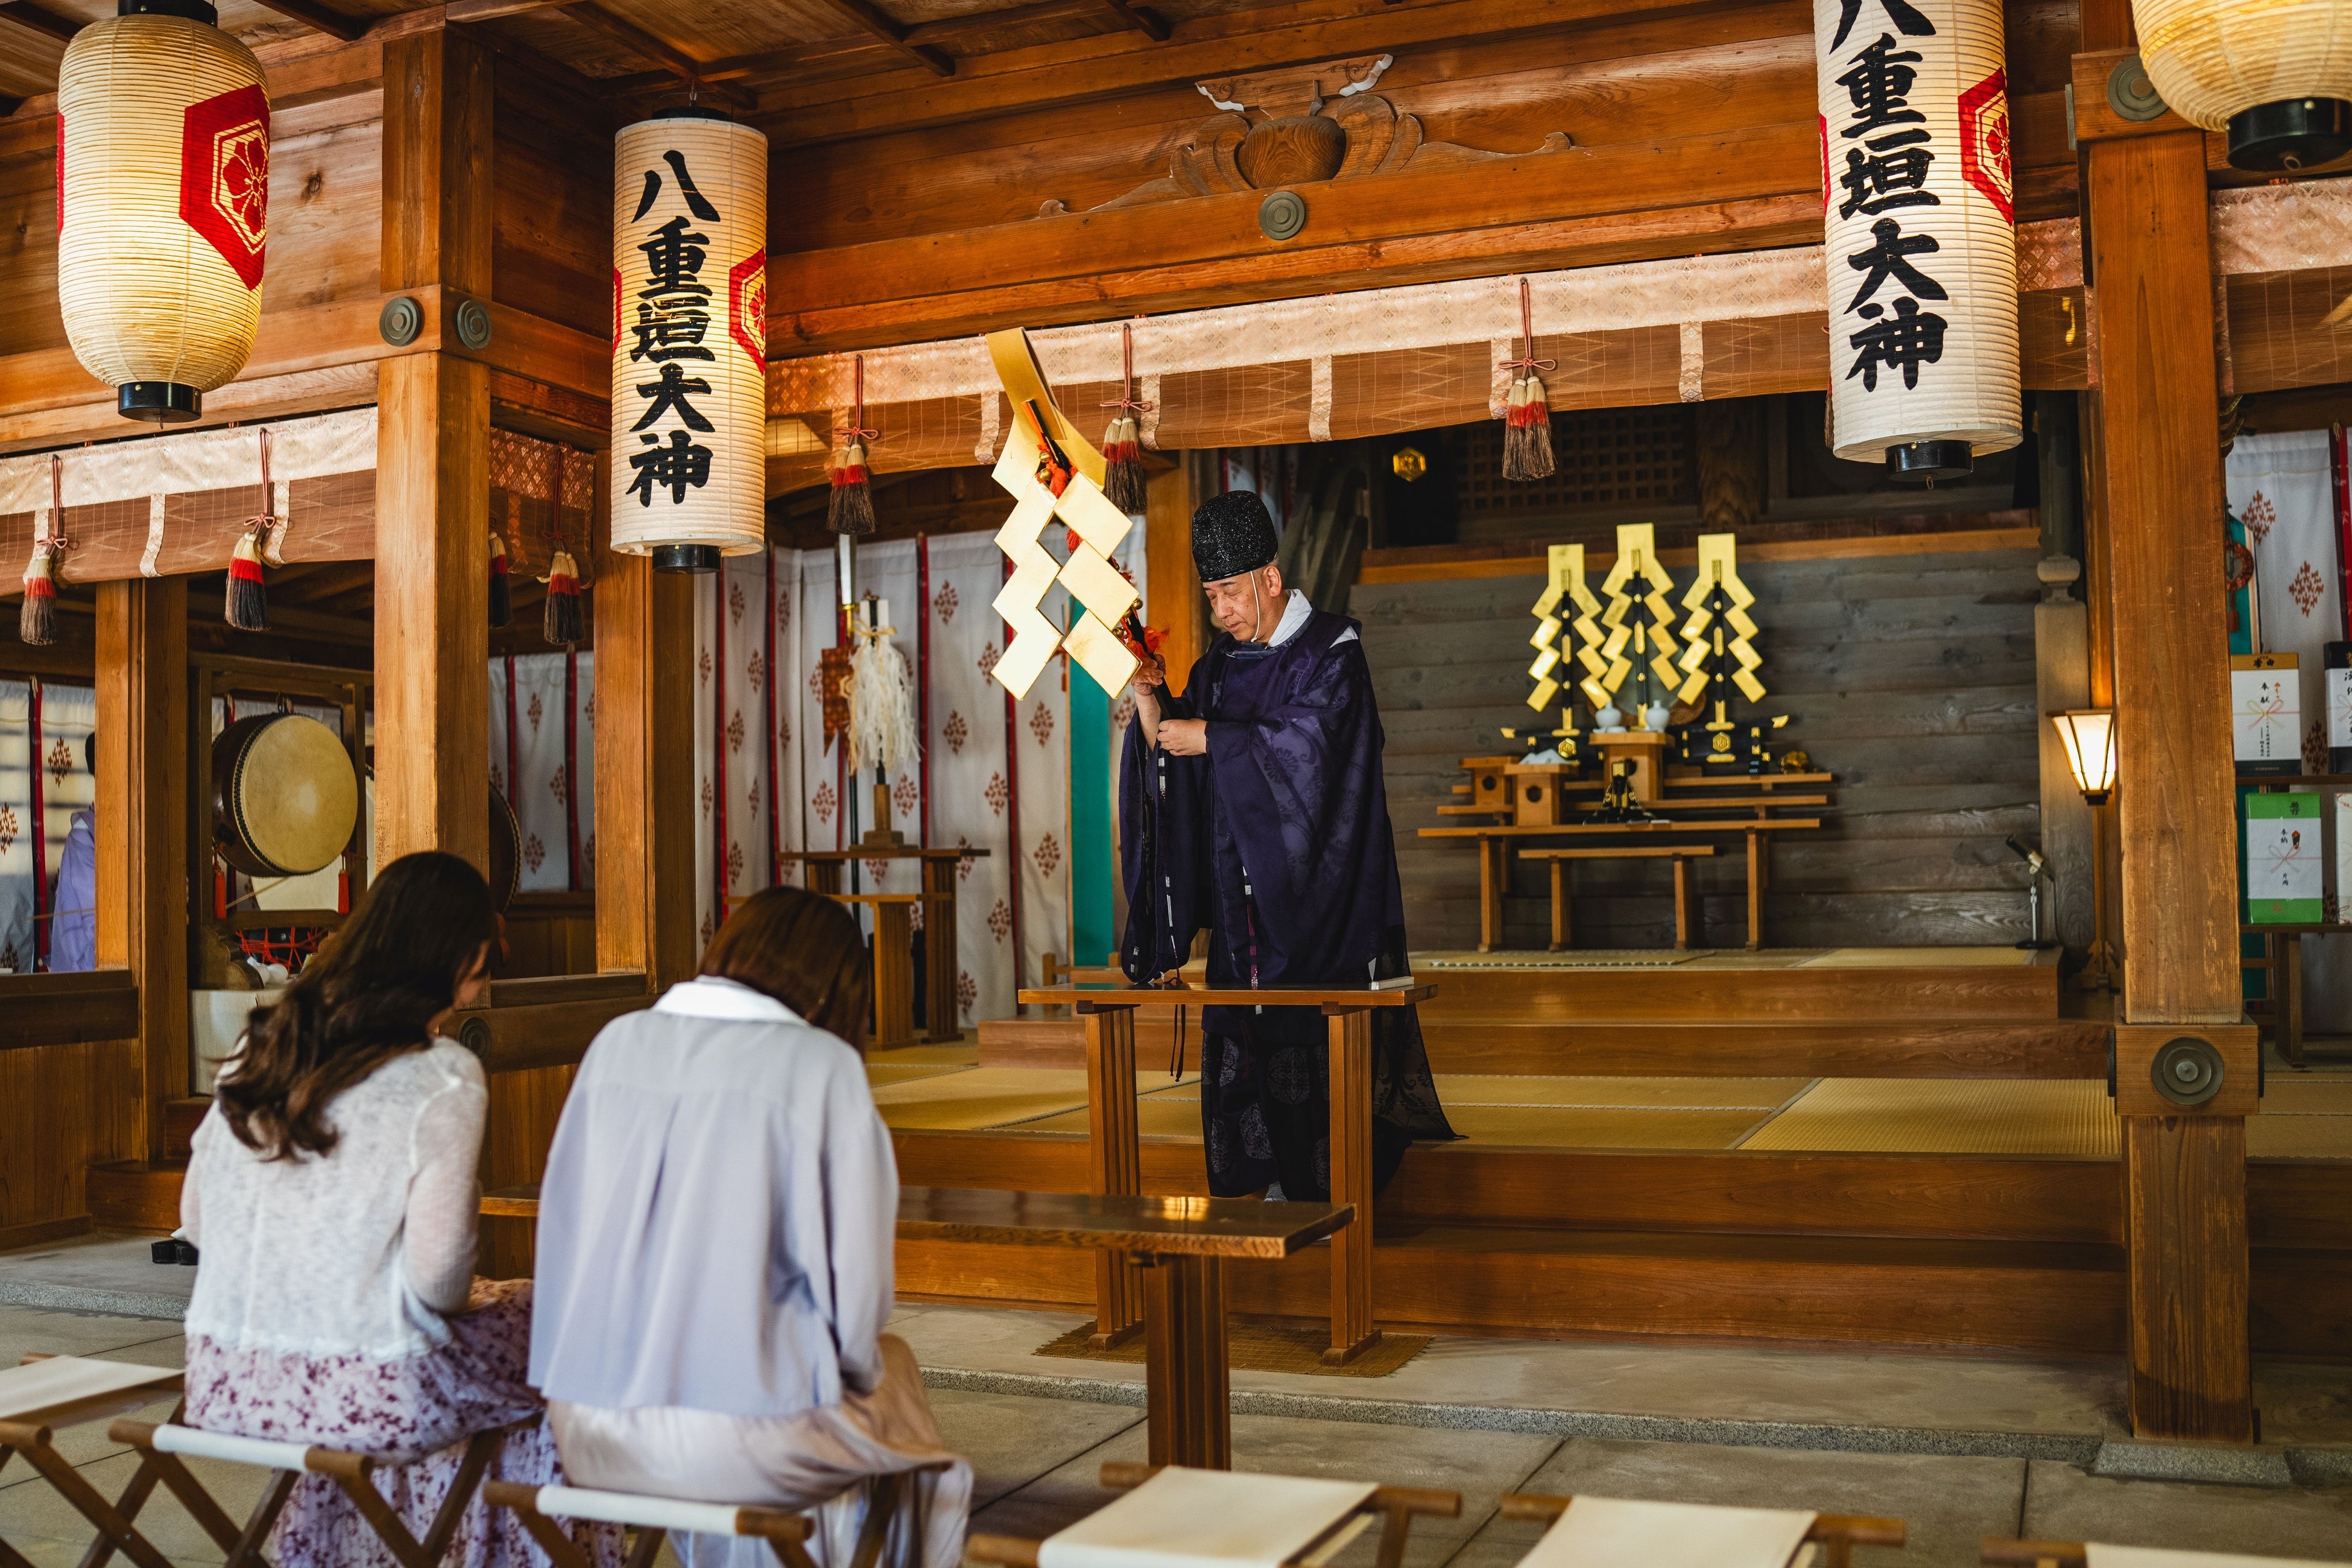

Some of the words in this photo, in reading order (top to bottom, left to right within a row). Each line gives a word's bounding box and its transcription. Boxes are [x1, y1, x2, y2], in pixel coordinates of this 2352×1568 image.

[625, 150, 721, 508] 八重垣大神
[1829, 0, 1949, 393] 八重垣大神
